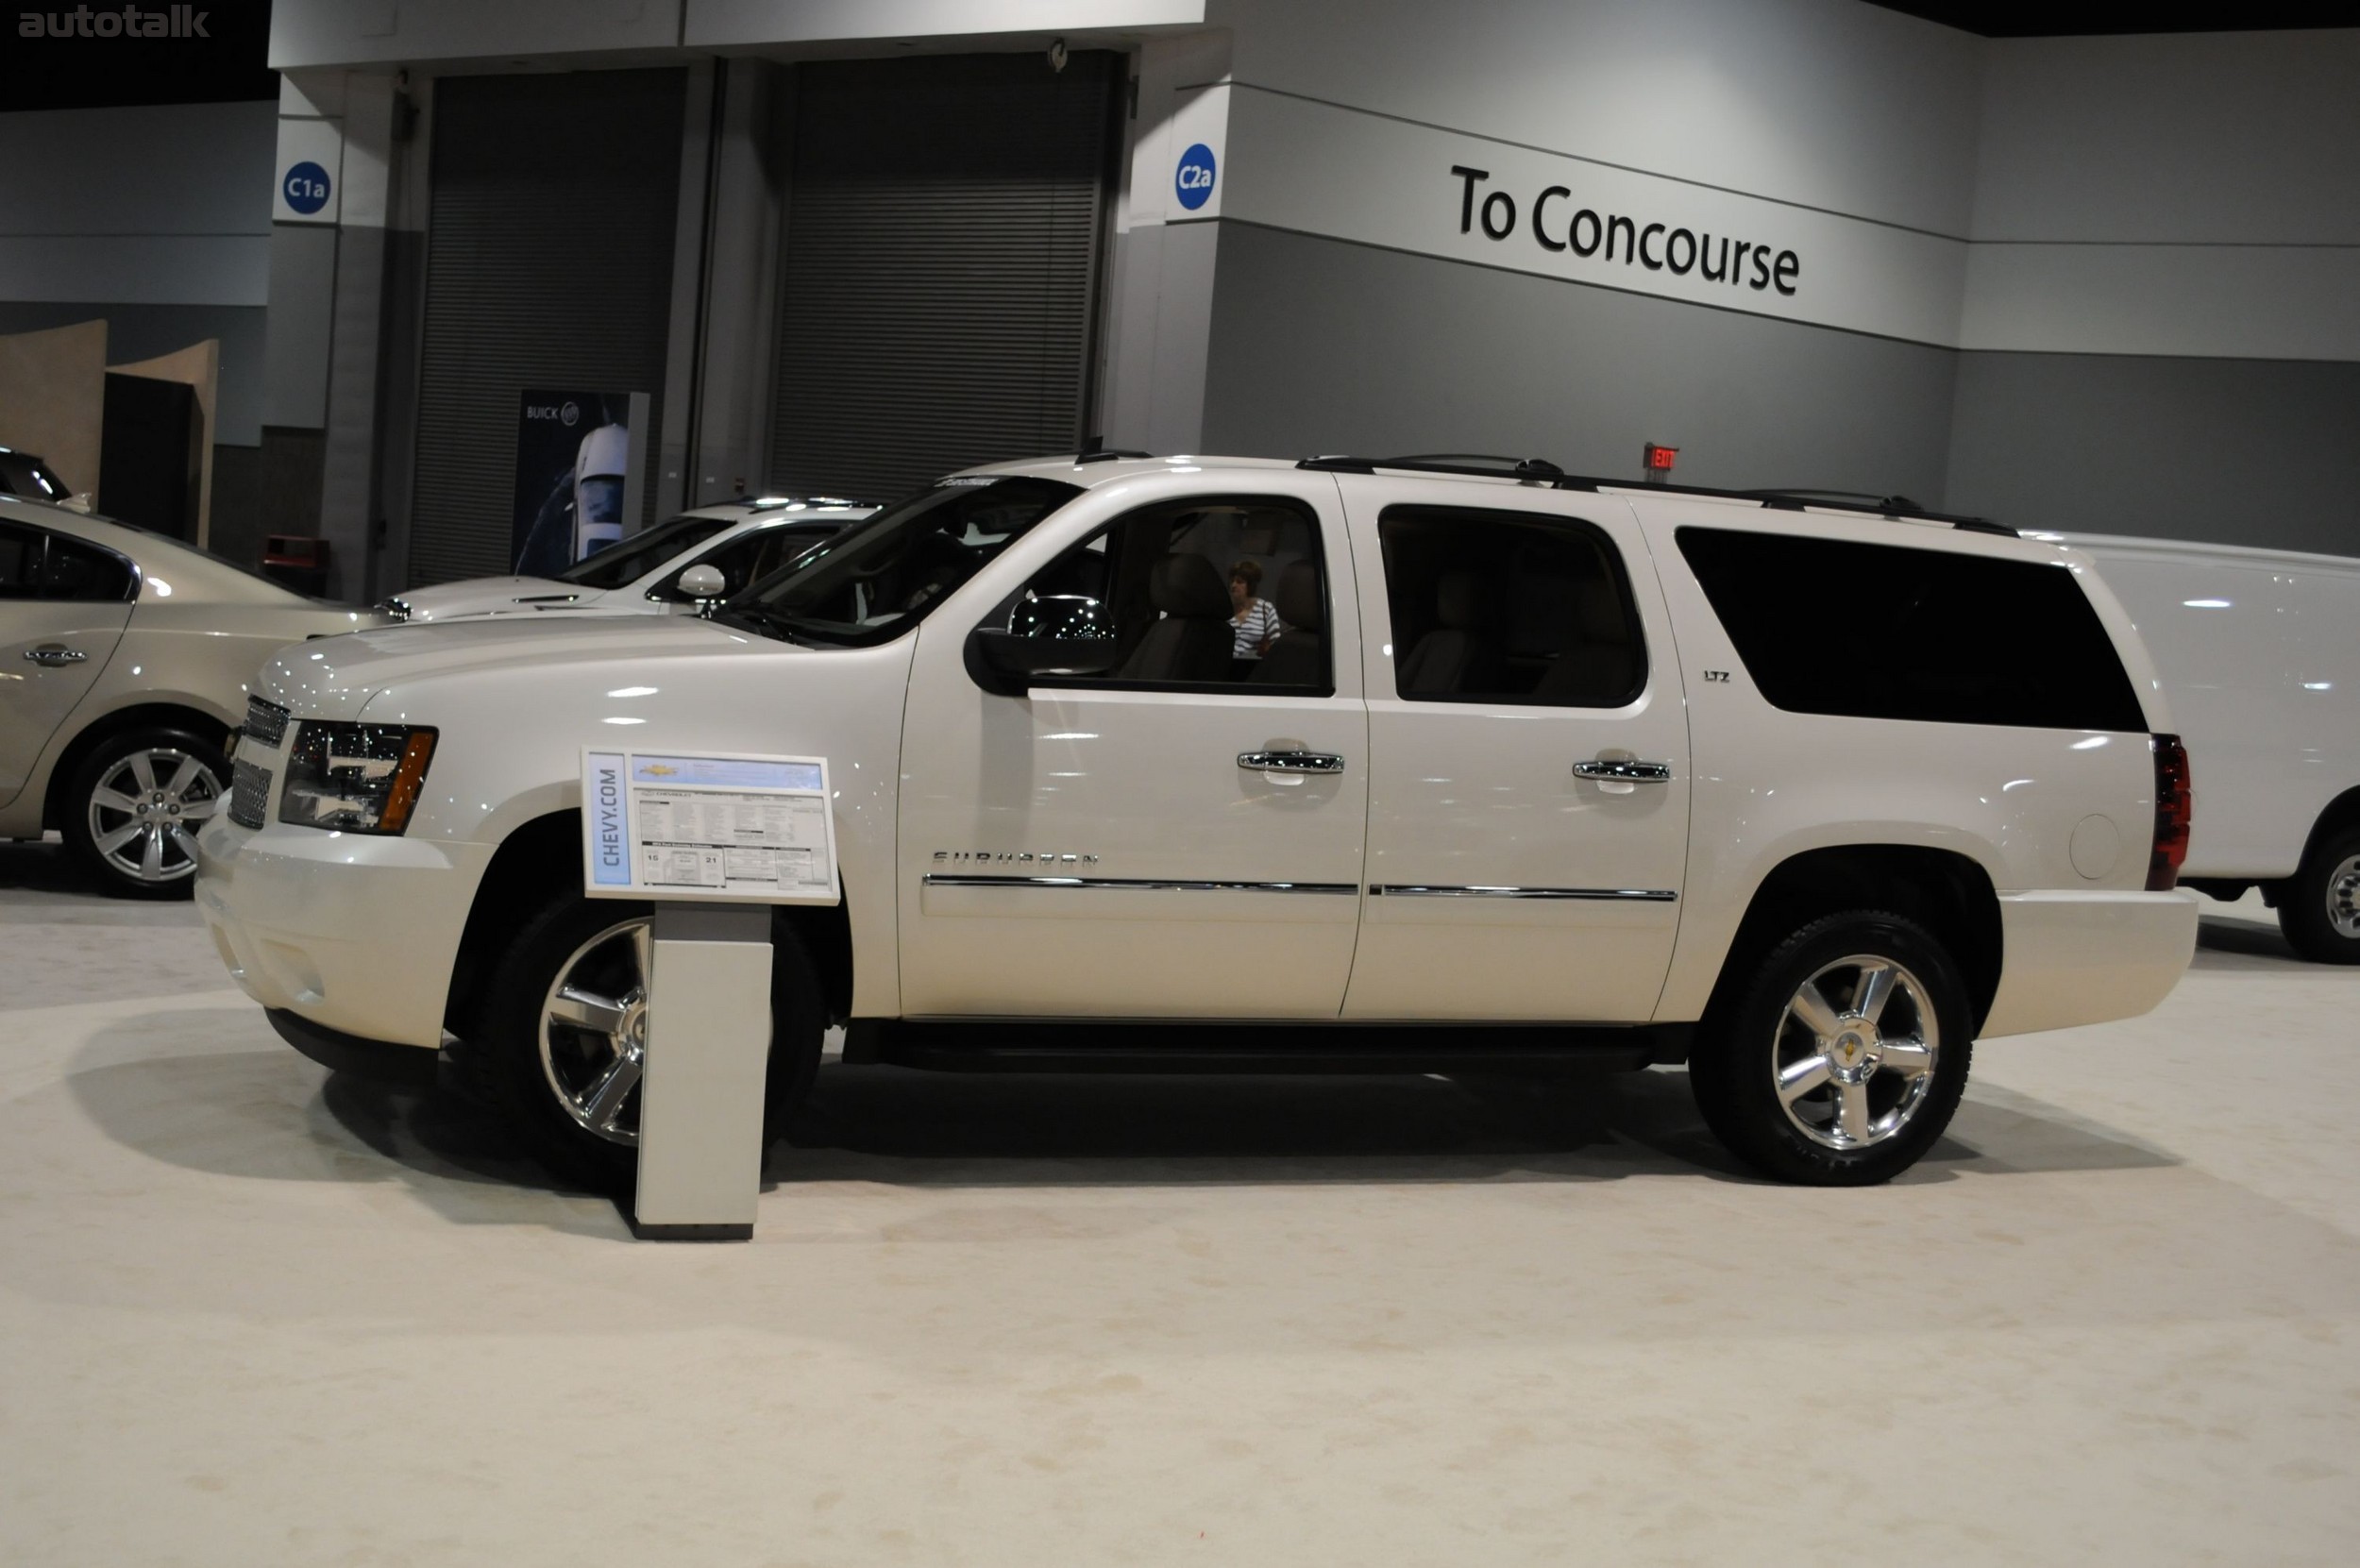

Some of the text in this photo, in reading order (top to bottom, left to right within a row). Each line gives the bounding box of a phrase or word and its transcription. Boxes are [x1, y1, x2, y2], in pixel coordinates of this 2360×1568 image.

[288, 177, 326, 198] C1a
[1178, 164, 1212, 190] C2a
[1451, 164, 1800, 296] To Concourse
[527, 405, 559, 420] BUICK
[1654, 447, 1676, 468] EXIT
[1704, 669, 1730, 683] LTZ
[599, 768, 620, 868] CHEVY.COM
